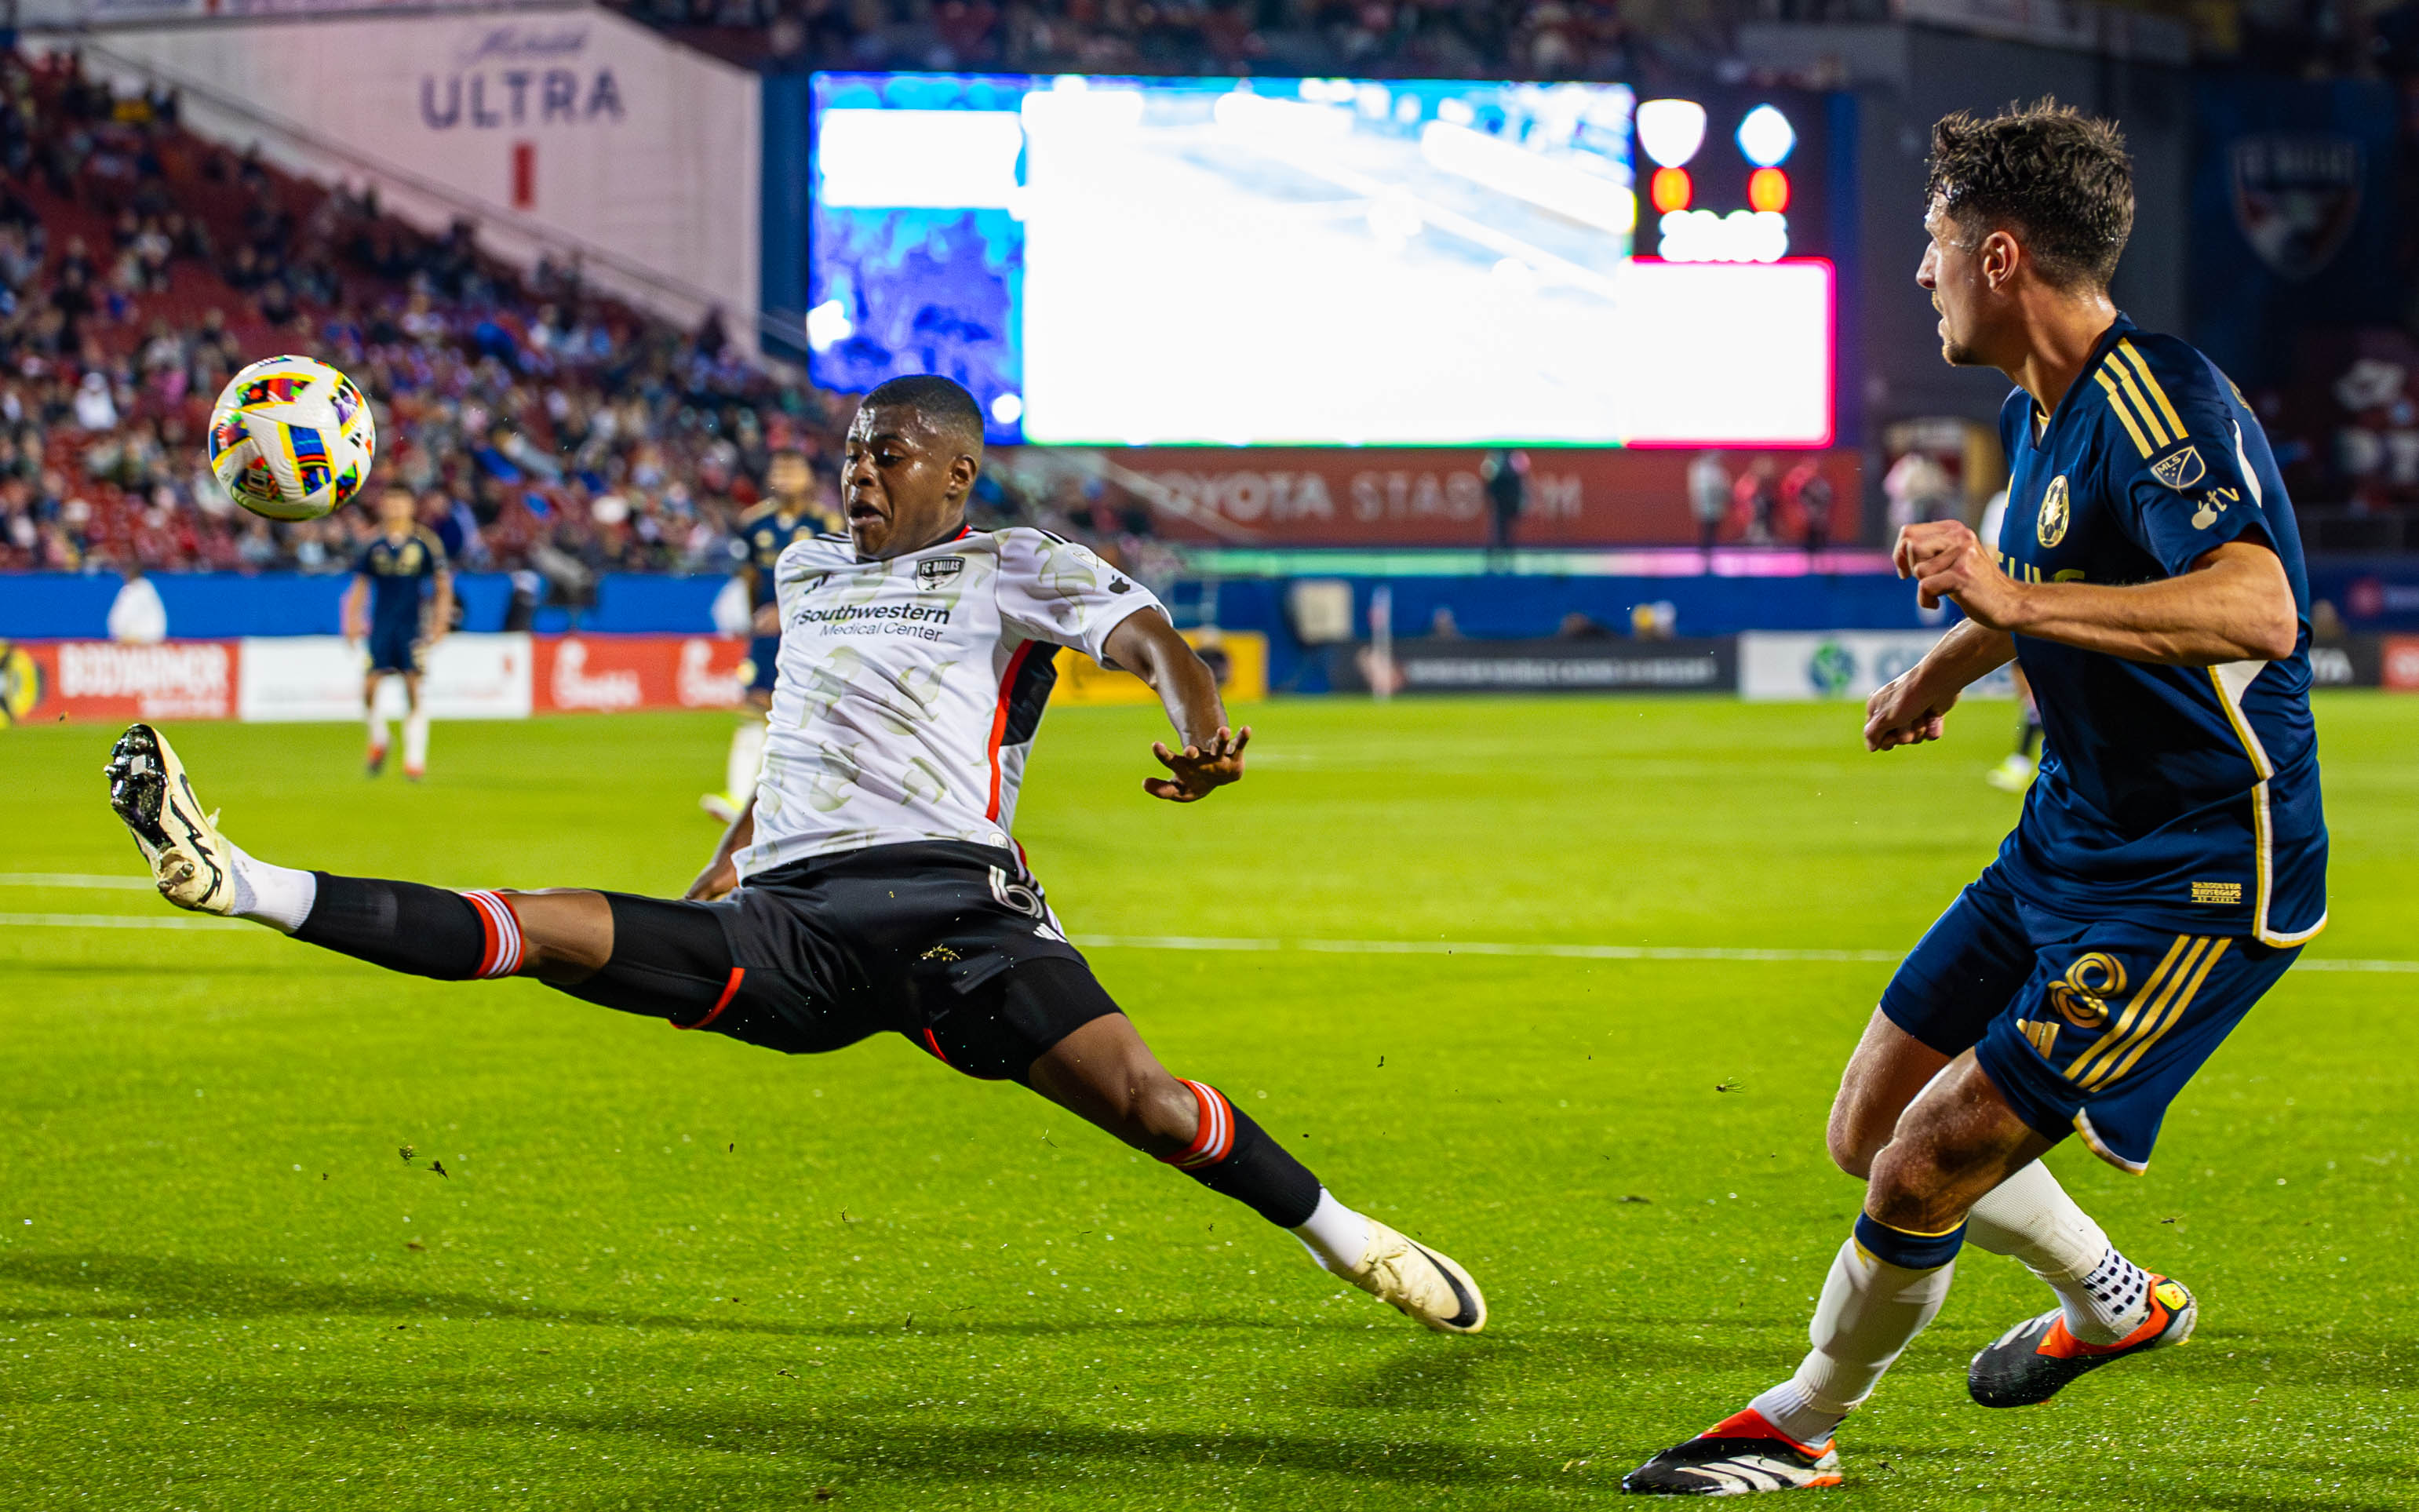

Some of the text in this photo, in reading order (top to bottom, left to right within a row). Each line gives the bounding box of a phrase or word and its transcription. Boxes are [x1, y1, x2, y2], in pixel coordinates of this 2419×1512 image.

[421, 68, 625, 129] ULTRA
[2156, 455, 2181, 474] MLS
[1136, 470, 1334, 520] OYOTA
[2206, 486, 2240, 512] tv
[798, 603, 950, 625] Southwestern
[819, 621, 944, 643] Medical Center
[989, 864, 1044, 919] 6
[2047, 951, 2128, 1029] 8
